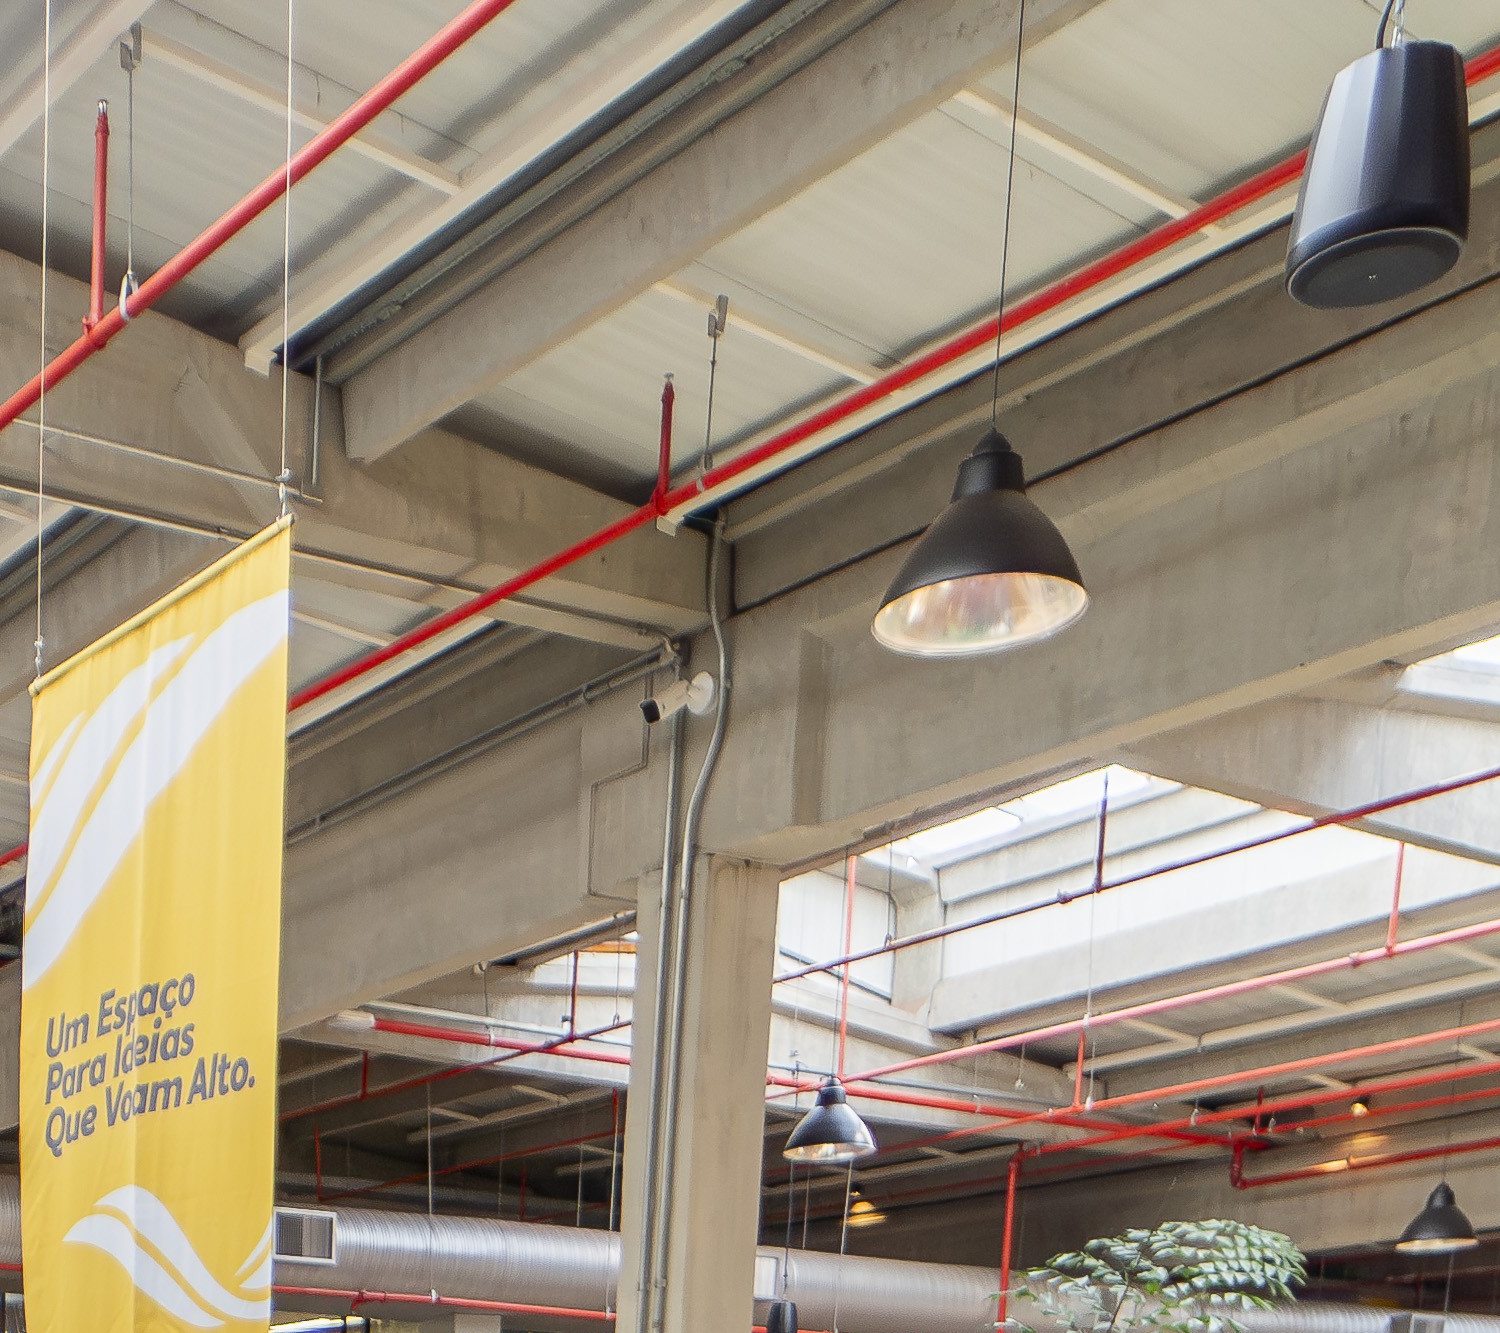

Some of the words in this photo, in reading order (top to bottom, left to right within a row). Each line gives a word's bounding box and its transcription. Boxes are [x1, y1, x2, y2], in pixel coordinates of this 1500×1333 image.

[46, 1011, 90, 1058] Um
[96, 973, 195, 1037] Espaço
[45, 1052, 107, 1105] Para
[113, 1016, 195, 1078] Ideias
[45, 1105, 97, 1157] Que
[105, 1076, 182, 1127] Voam
[186, 1052, 255, 1105] Alto.
